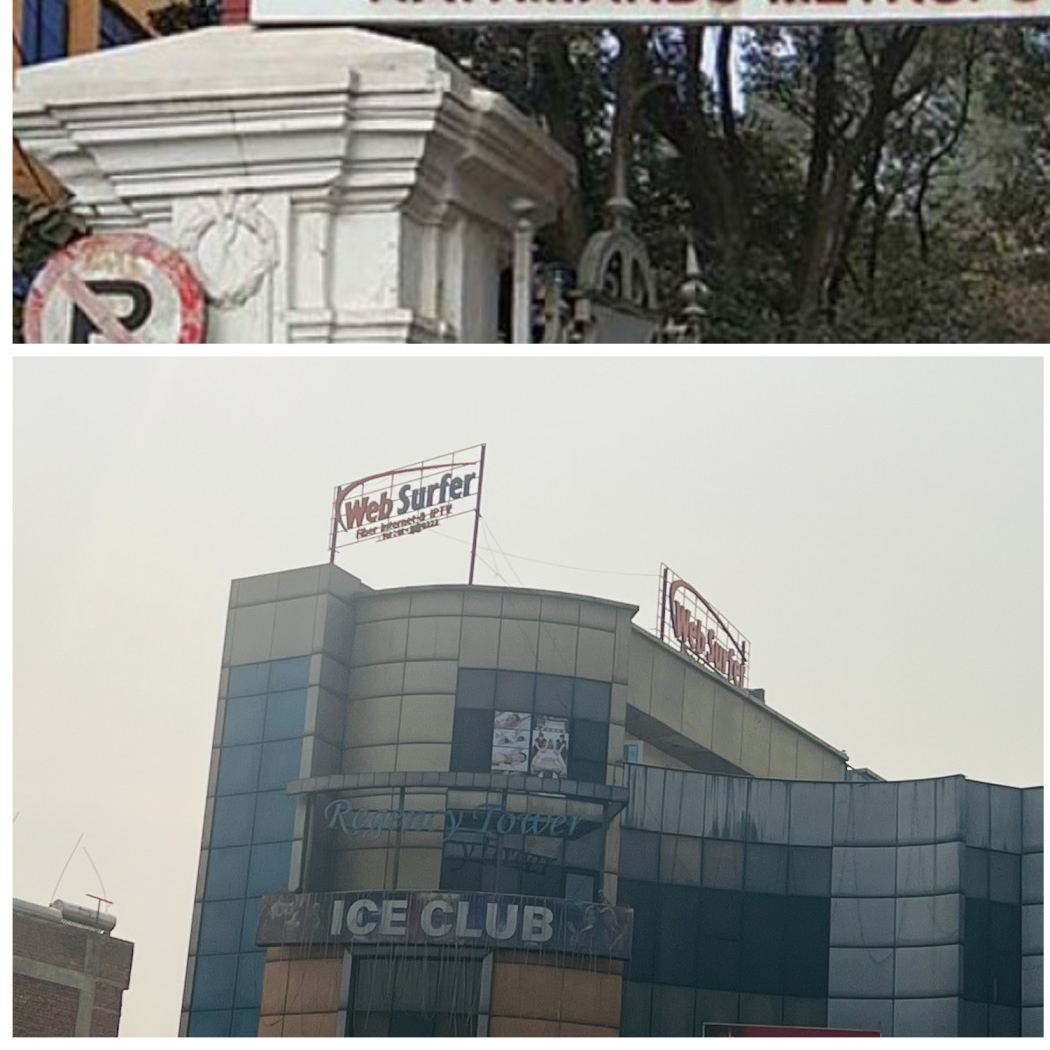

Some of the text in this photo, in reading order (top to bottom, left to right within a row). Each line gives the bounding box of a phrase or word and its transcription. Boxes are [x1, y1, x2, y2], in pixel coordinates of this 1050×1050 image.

[345, 491, 393, 530] Web
[397, 471, 476, 516] Surfer
[673, 600, 706, 656] Web
[330, 899, 554, 942] ICE CLUB
